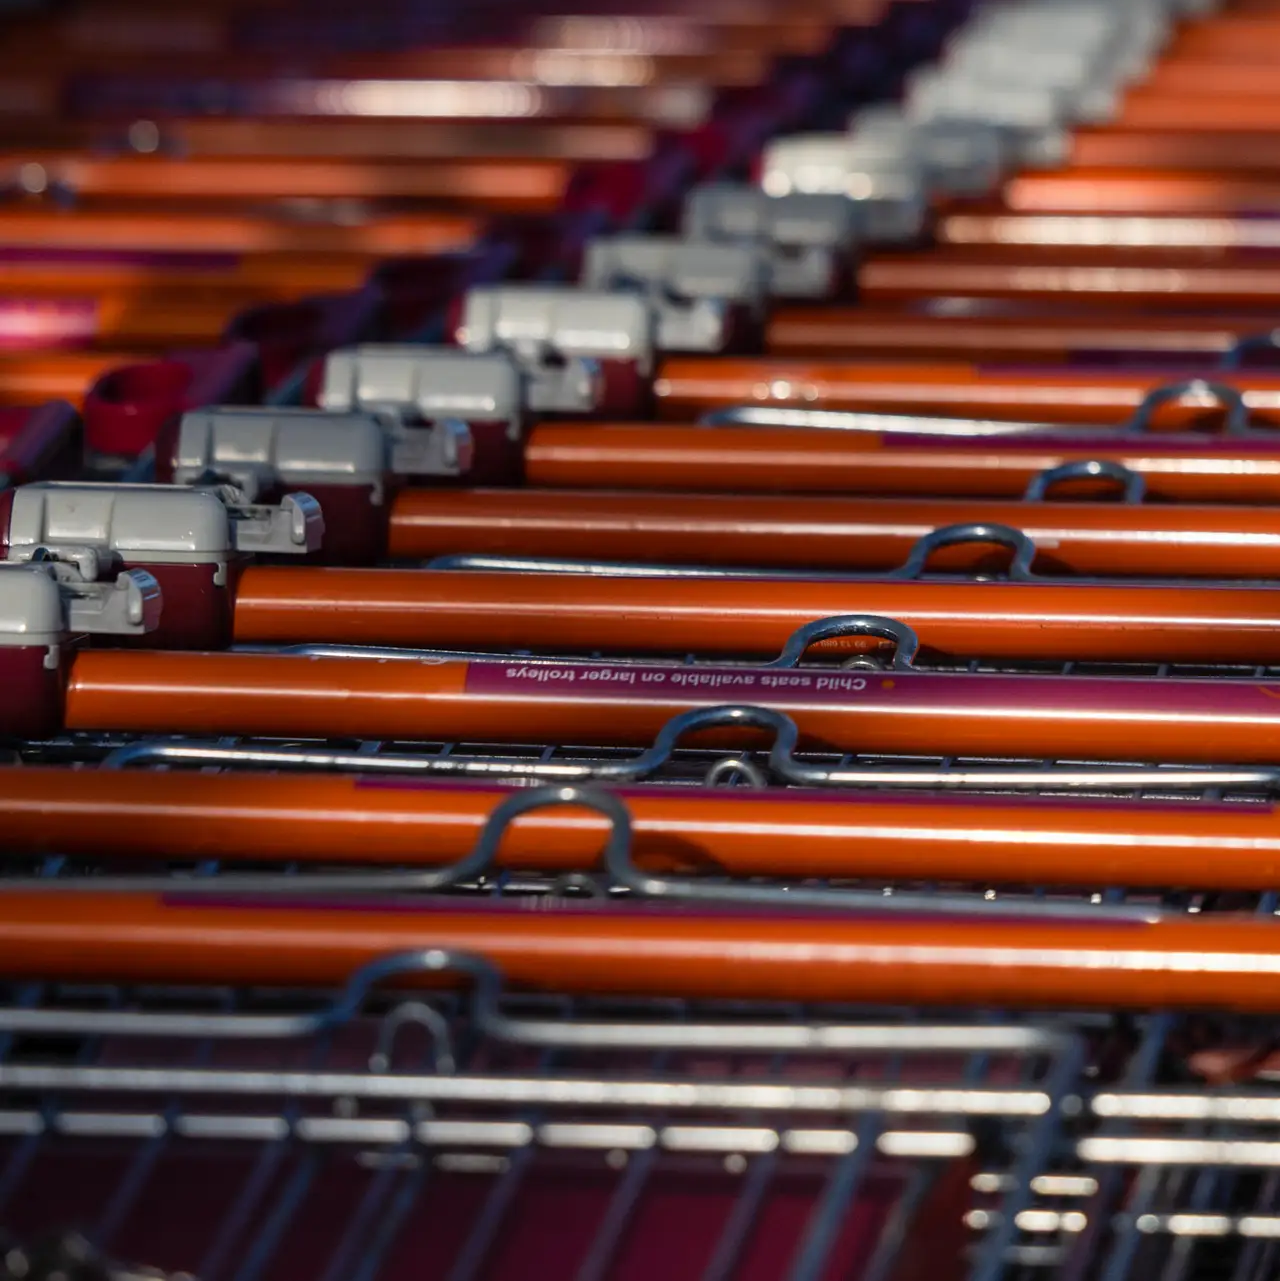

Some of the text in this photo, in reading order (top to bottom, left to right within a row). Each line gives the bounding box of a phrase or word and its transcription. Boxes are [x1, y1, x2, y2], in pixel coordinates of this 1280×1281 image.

[505, 666, 868, 691] Child seats available on larger trolleys
